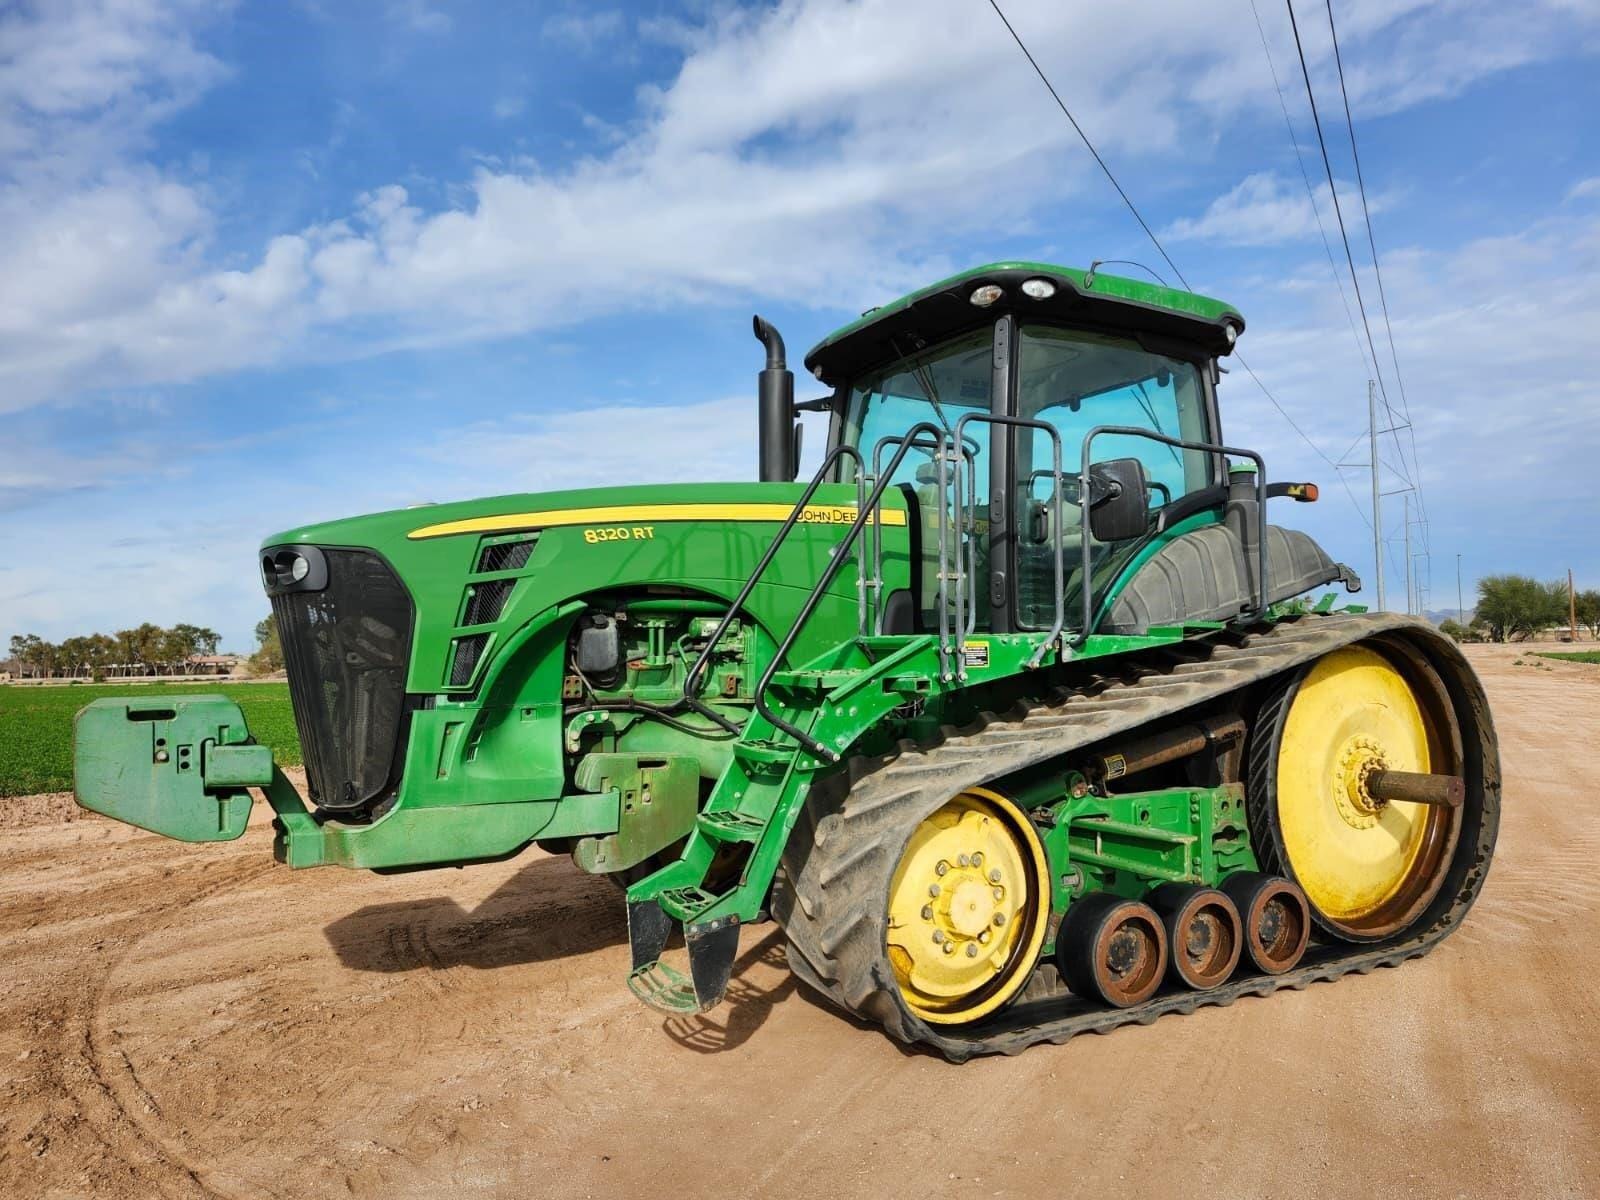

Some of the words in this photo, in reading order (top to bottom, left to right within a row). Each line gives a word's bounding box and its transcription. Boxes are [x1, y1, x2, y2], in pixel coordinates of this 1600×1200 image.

[797, 510, 831, 521] JOHN
[833, 509, 873, 523] DEEE
[584, 527, 630, 544] 8320
[632, 526, 655, 541] RT
